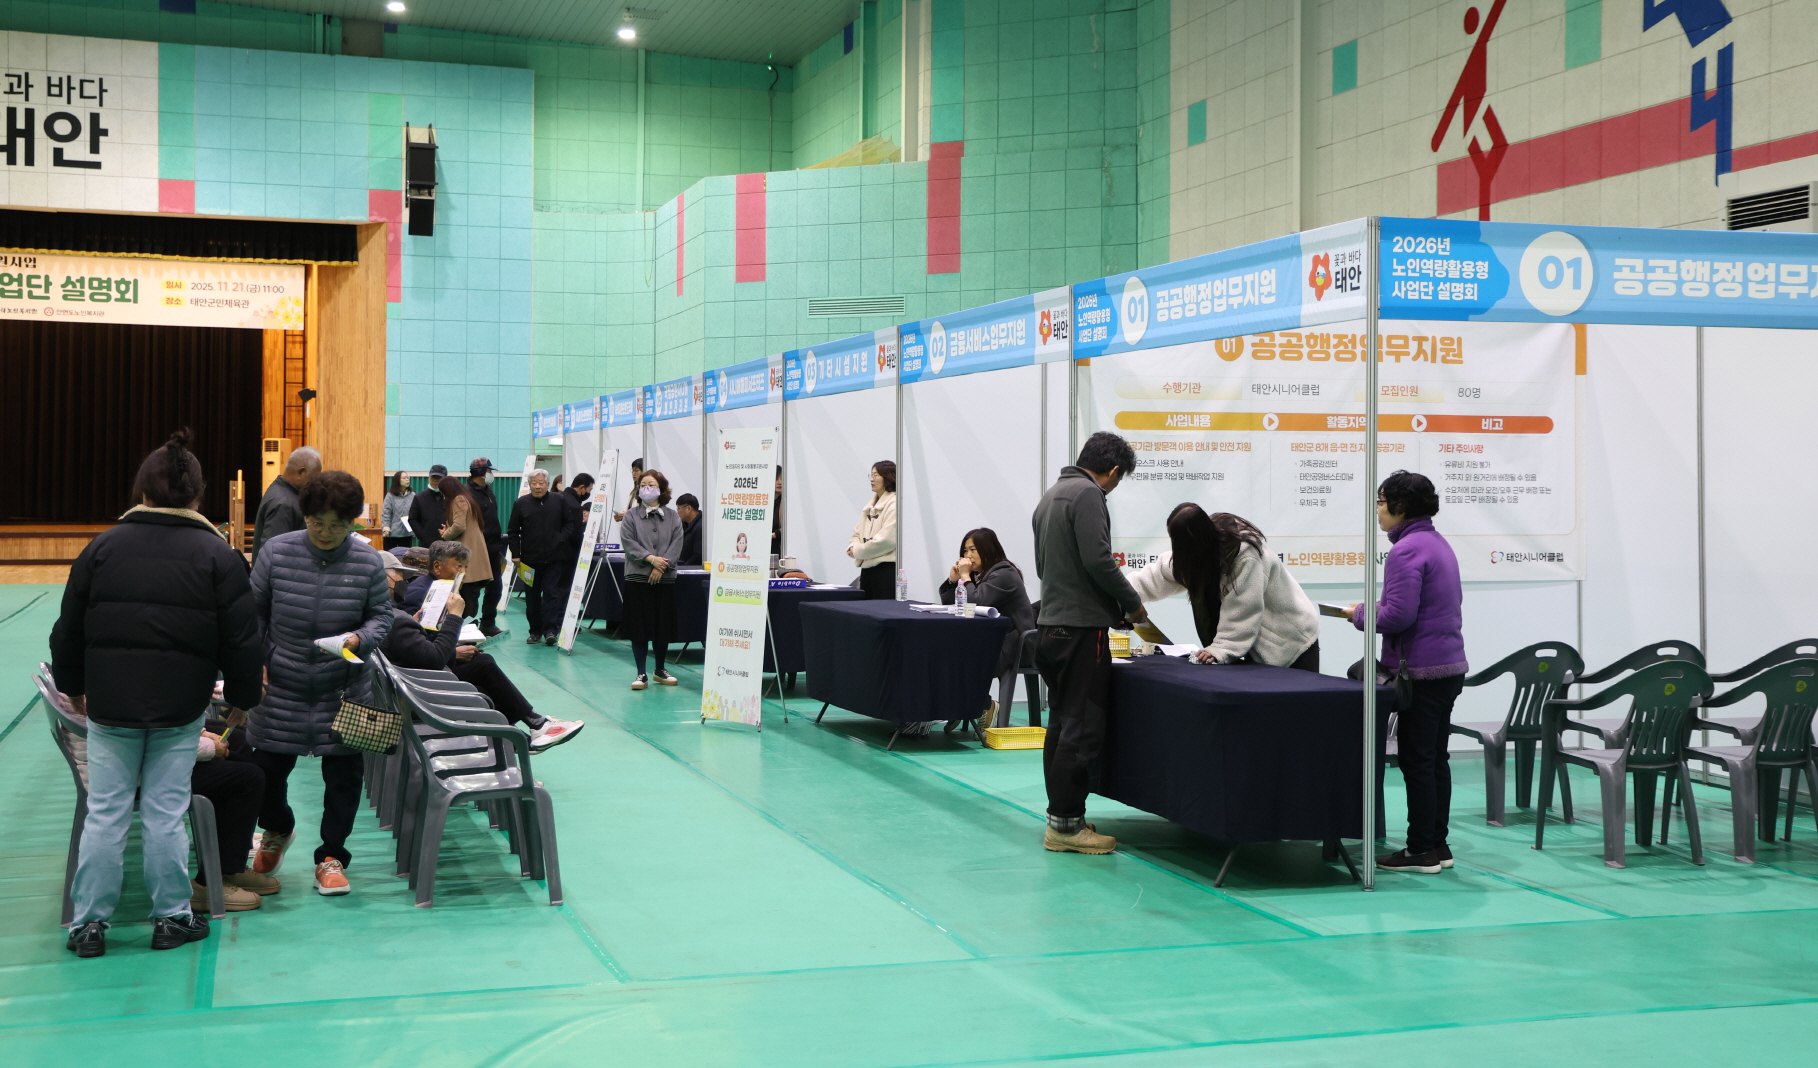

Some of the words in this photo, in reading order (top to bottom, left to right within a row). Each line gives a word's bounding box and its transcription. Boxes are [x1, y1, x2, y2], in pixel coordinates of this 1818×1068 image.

[47, 75, 108, 107] 바다
[1392, 236, 1451, 255] 2026년
[1334, 252, 1347, 267] 꽃과
[1348, 249, 1362, 264] 바다
[1391, 259, 1489, 279] 노인역량활용형
[1537, 255, 1583, 290] 01
[166, 281, 182, 289] 일시
[1335, 265, 1362, 293] 태안
[60, 275, 139, 304] 설명회
[191, 282, 215, 291] 2025.
[217, 282, 230, 291] 11.
[262, 285, 285, 294] 11:00
[1156, 268, 1276, 322] 공공행정업무지원
[1391, 281, 1434, 299] 사업단
[1437, 281, 1478, 301] 설명회
[166, 297, 182, 305] 장소
[190, 298, 250, 309] 태안군민체육관
[1077, 294, 1098, 309] 2026년
[1128, 295, 1146, 323] 01
[1078, 308, 1111, 328] 노인역량활용형
[1053, 320, 1068, 340] 태안
[1078, 328, 1092, 343] 사업단
[1093, 325, 1108, 341] 설명회
[950, 319, 1026, 357] 금융서비스업무지원
[1222, 338, 1236, 353] 01
[932, 335, 944, 358] 02
[807, 362, 816, 381] 03
[1162, 382, 1202, 394] 수행기관
[1252, 384, 1320, 396] 태안시니어클럽
[1381, 385, 1419, 397] 모집인원
[1457, 387, 1481, 399] 80명
[1165, 414, 1211, 428] 사업내용
[1481, 418, 1504, 431] 비고
[1154, 442, 1177, 452] 방문객
[1178, 442, 1193, 452] 이용
[1195, 442, 1210, 452] 안내
[1211, 442, 1218, 452] 및
[1219, 442, 1235, 452] 안전
[1236, 442, 1252, 452] 지원
[1291, 443, 1314, 452] 태안군
[1315, 443, 1329, 452] 8개
[1349, 443, 1357, 452] 전
[1358, 443, 1366, 452] 지
[1439, 444, 1454, 453] 기타
[1455, 444, 1484, 453] 주의사항
[1156, 459, 1170, 467] 사용
[1299, 460, 1338, 468] 가족공감센터
[1479, 461, 1491, 469] 불가
[734, 477, 758, 489] 2026년
[1150, 473, 1163, 481] 분류
[1178, 473, 1185, 481] 및
[1299, 473, 1354, 481] 태안공영버스터미널
[1299, 486, 1332, 494] 보건의료원
[721, 493, 769, 506] 노인역량활용형
[1299, 499, 1319, 507] 우체국
[1320, 499, 1327, 507] 등
[722, 508, 743, 520] 사업단
[744, 508, 766, 521] 설명회
[1128, 559, 1146, 568] 태안
[1506, 552, 1564, 562] 태안시니어클럽
